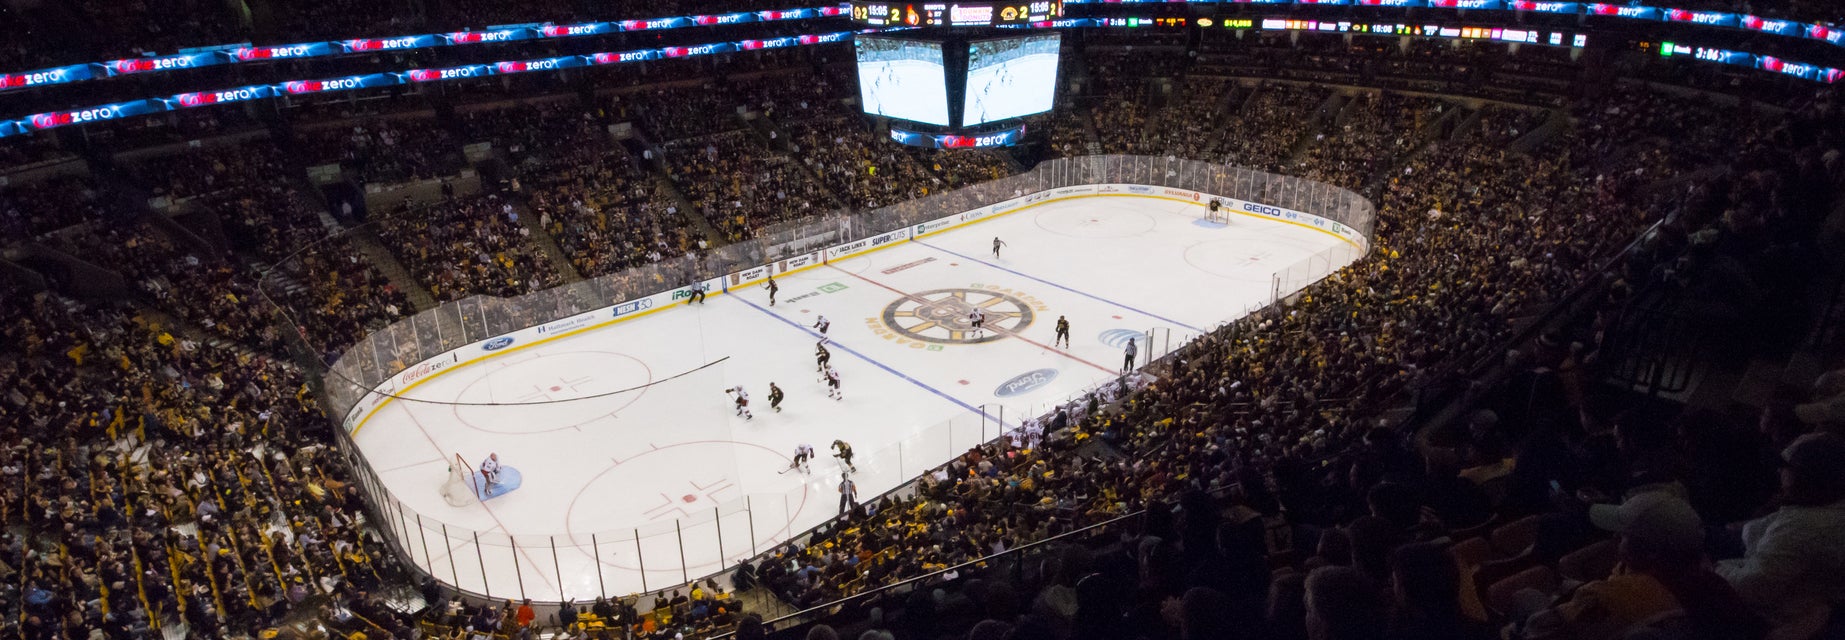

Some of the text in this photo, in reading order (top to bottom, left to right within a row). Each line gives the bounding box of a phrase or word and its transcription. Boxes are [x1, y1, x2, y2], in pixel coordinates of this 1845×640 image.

[868, 6, 888, 16] 15:05
[1020, 6, 1028, 19] 2
[1030, 2, 1049, 13] 15:05
[1050, 3, 1056, 16] 2
[891, 8, 900, 21] 2
[1243, 203, 1281, 217] GEICO
[872, 231, 906, 246] SUPERCUTS
[618, 303, 636, 315] NESN
